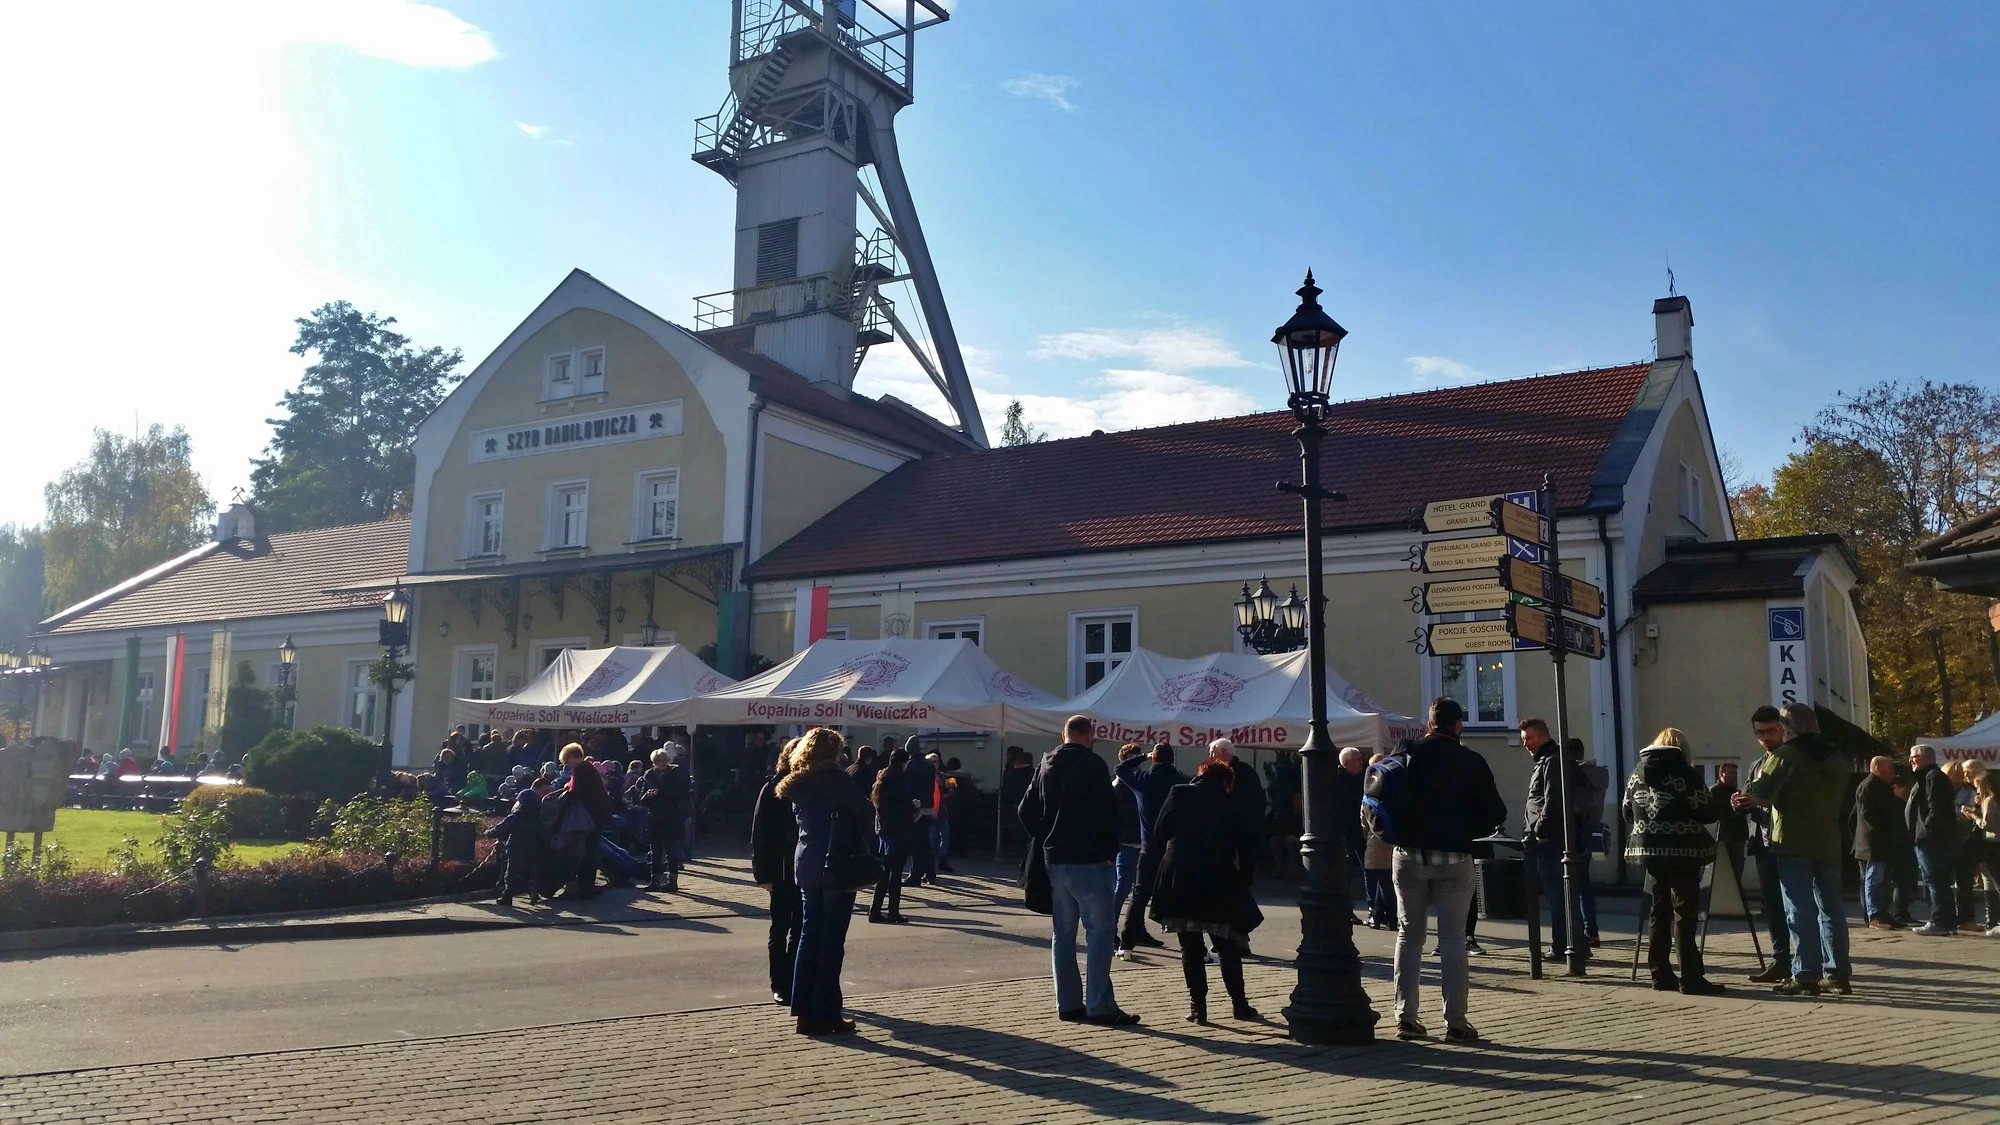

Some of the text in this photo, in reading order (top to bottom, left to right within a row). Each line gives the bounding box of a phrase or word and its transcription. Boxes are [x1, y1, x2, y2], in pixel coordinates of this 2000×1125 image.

[1433, 500, 1487, 513] HOTEL GRAND
[1446, 516, 1468, 525] GRAND
[1470, 515, 1481, 523] SAL
[1430, 544, 1470, 552] RESTAURACJA
[1431, 586, 1471, 594] UZDROWISKO
[1439, 627, 1467, 635] POKOJE
[488, 707, 535, 723] Kopalnia
[538, 710, 560, 723] Soli
[747, 702, 810, 719] Kopalnia
[814, 702, 843, 717] Soli
[1087, 719, 1287, 746] ieliczka Salt Mine
